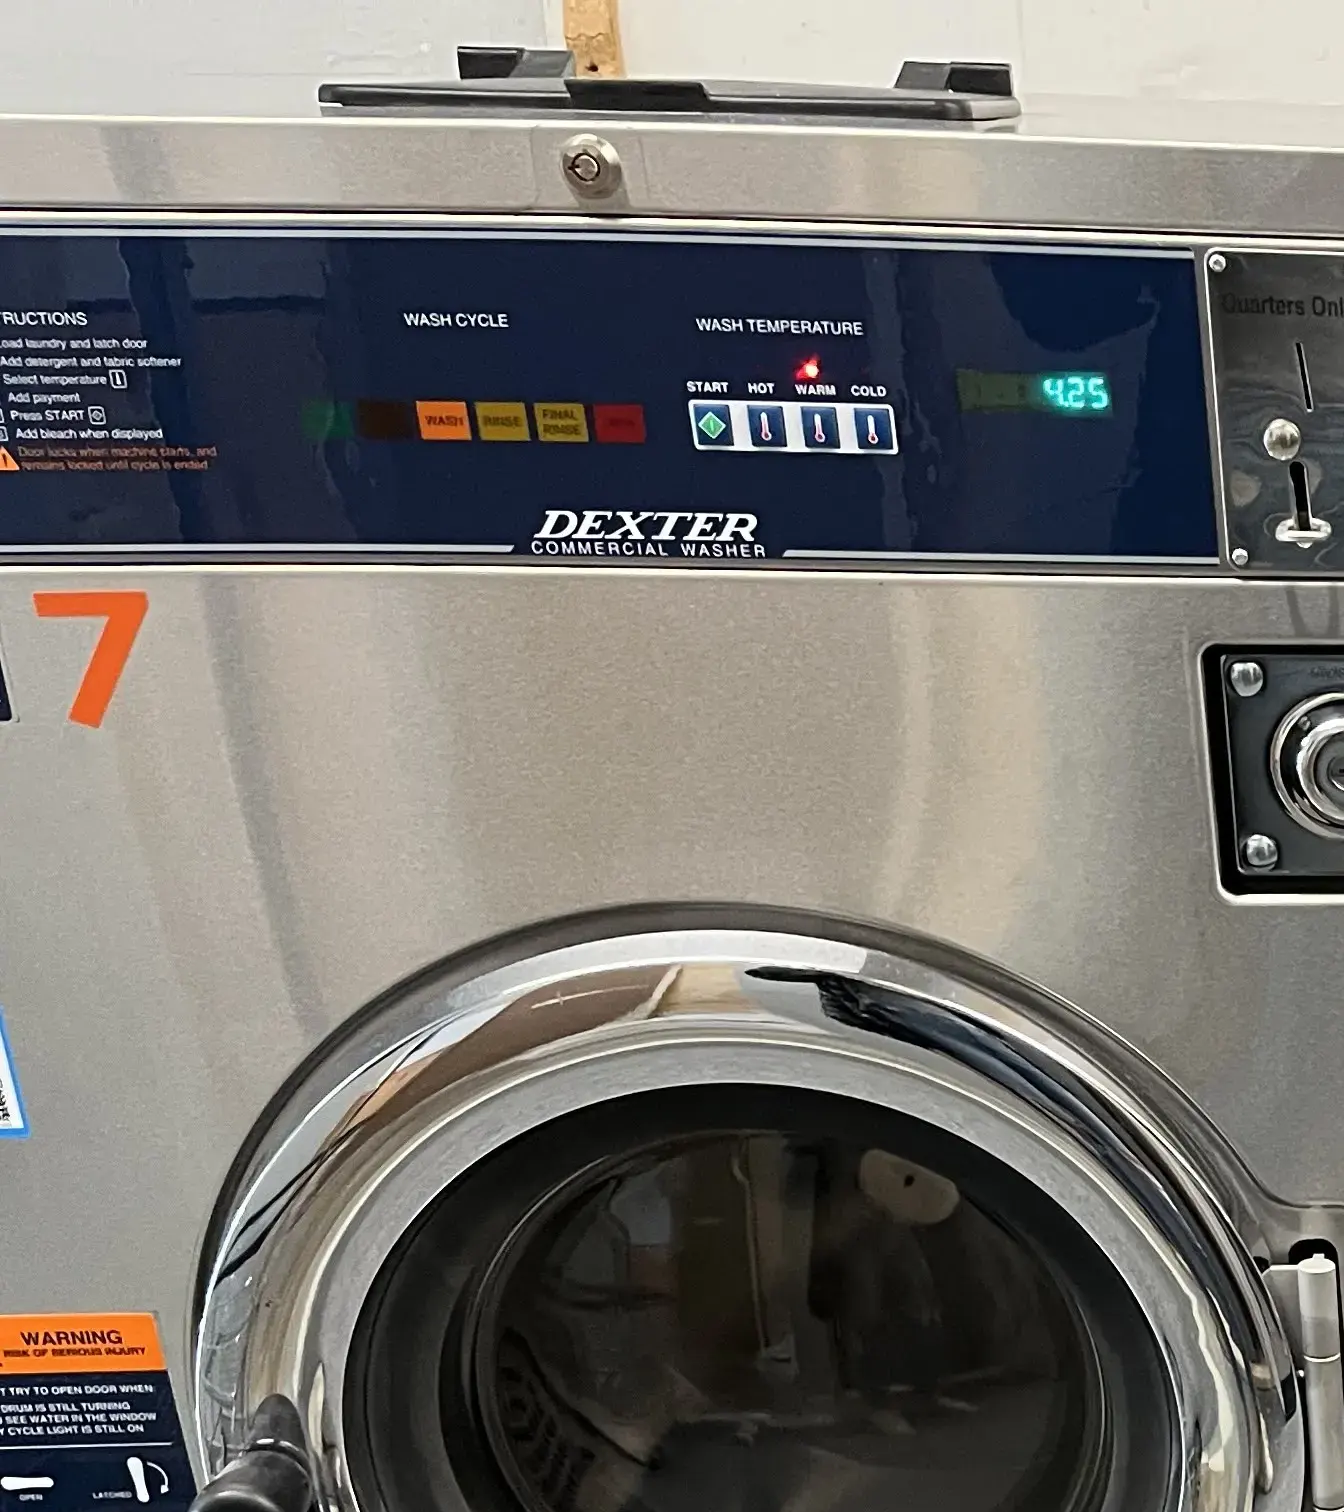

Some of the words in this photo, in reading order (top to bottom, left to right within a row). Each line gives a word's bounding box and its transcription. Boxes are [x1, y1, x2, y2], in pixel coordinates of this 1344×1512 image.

[1222, 294, 1304, 316] Quarters
[404, 313, 452, 326] WASH
[456, 313, 509, 328] CYCLE
[696, 318, 743, 331] WASH
[746, 319, 864, 335] TEMPERATURE
[26, 339, 66, 350] laundry
[70, 339, 90, 349] and
[93, 339, 119, 349] latch
[122, 339, 147, 349] door
[0, 357, 22, 366] Add
[26, 357, 78, 369] detergent
[81, 357, 100, 366] and
[104, 357, 134, 367] fabric
[138, 357, 181, 367] softener
[3, 374, 38, 385] Select
[40, 375, 107, 386] temperature
[687, 381, 728, 393] START
[748, 383, 775, 394] HOT
[795, 384, 836, 395] WARM
[851, 385, 886, 397] COLD
[8, 393, 30, 402] Add
[33, 393, 80, 405] payment
[10, 410, 42, 421] Press
[45, 411, 84, 420] START
[16, 428, 38, 438] Add
[40, 428, 77, 438] bleach
[79, 429, 109, 438] when
[111, 428, 163, 441] displayed
[533, 510, 758, 541] DEXTER
[531, 541, 669, 557] COMMERCIAL
[680, 543, 766, 558] WASHER
[32, 590, 149, 729] 7
[20, 1330, 123, 1346] WARNING
